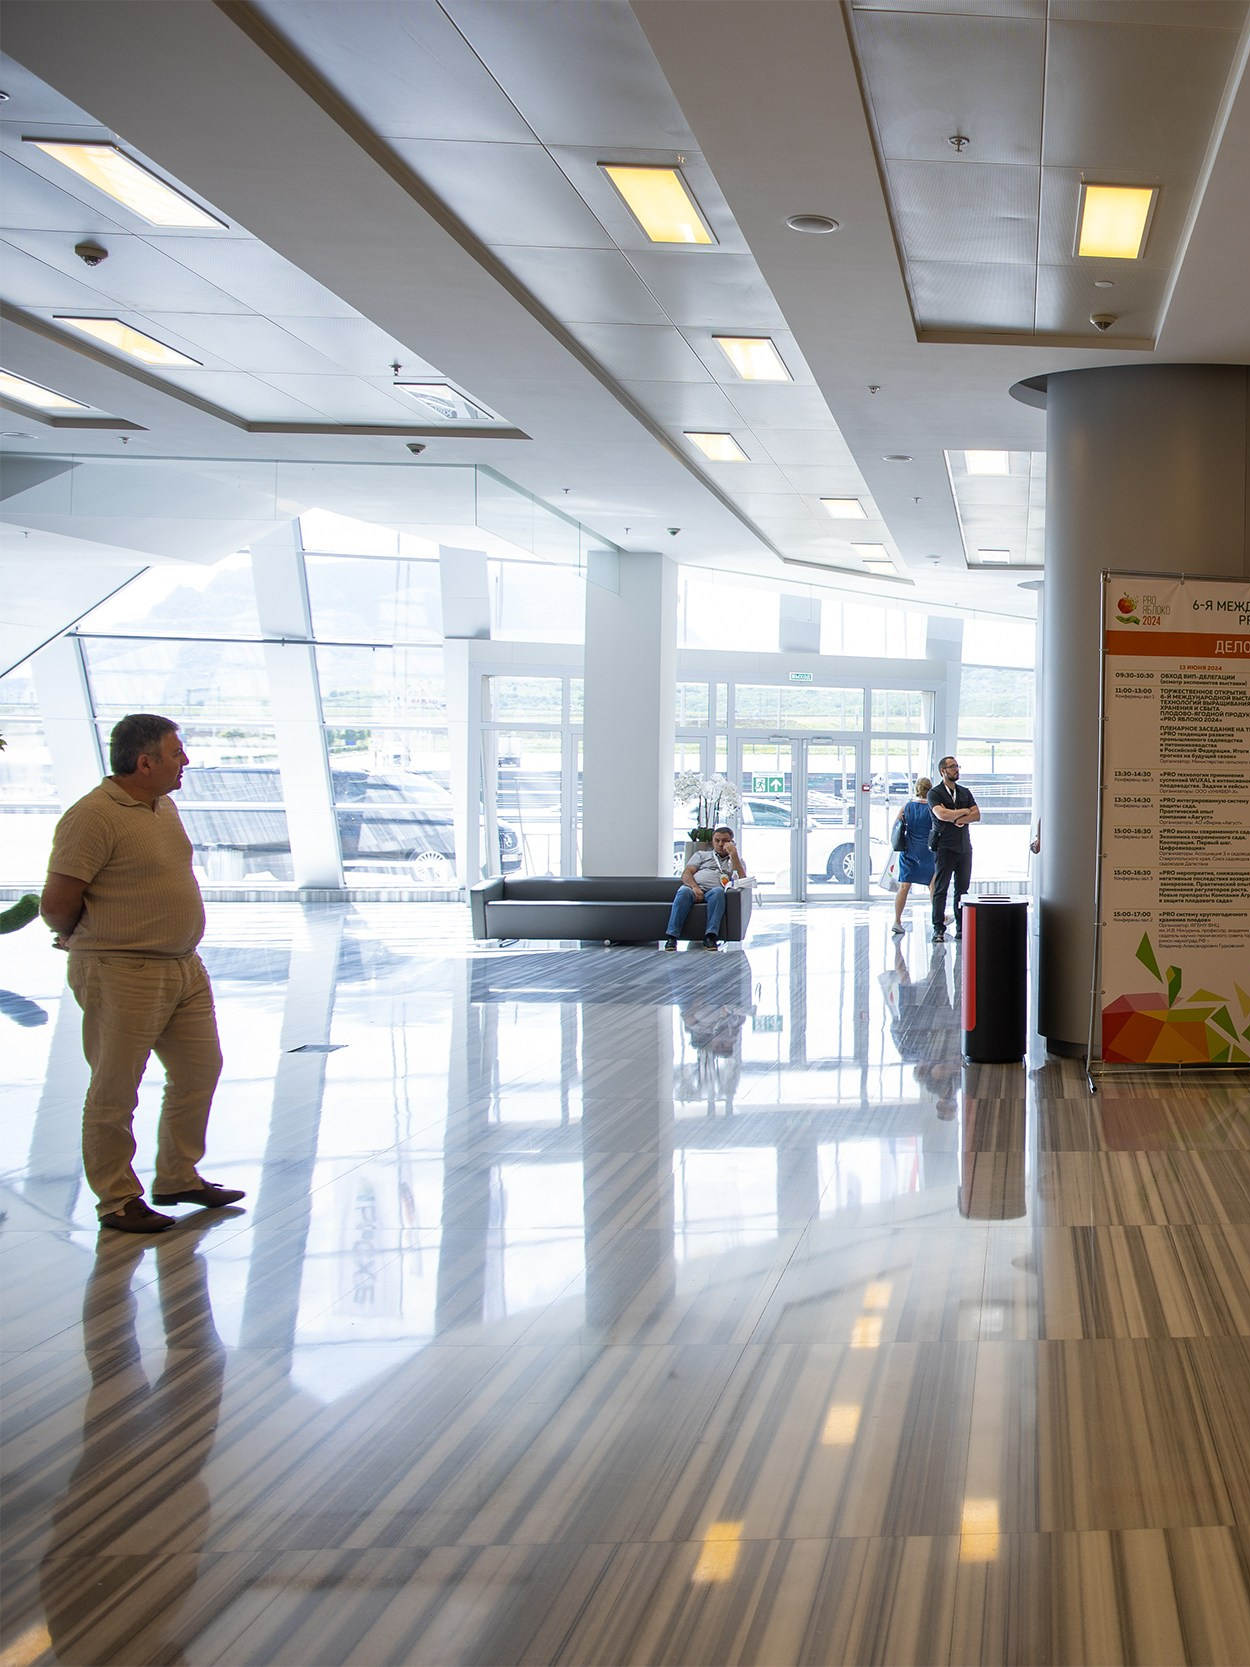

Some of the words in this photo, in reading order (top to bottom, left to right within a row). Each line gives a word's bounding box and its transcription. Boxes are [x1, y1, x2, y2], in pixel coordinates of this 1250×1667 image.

[1142, 595, 1156, 605] PRO
[1142, 604, 1170, 616] ЯБЛОКО
[1192, 600, 1213, 611] 6-Я
[1142, 616, 1160, 626] 2024
